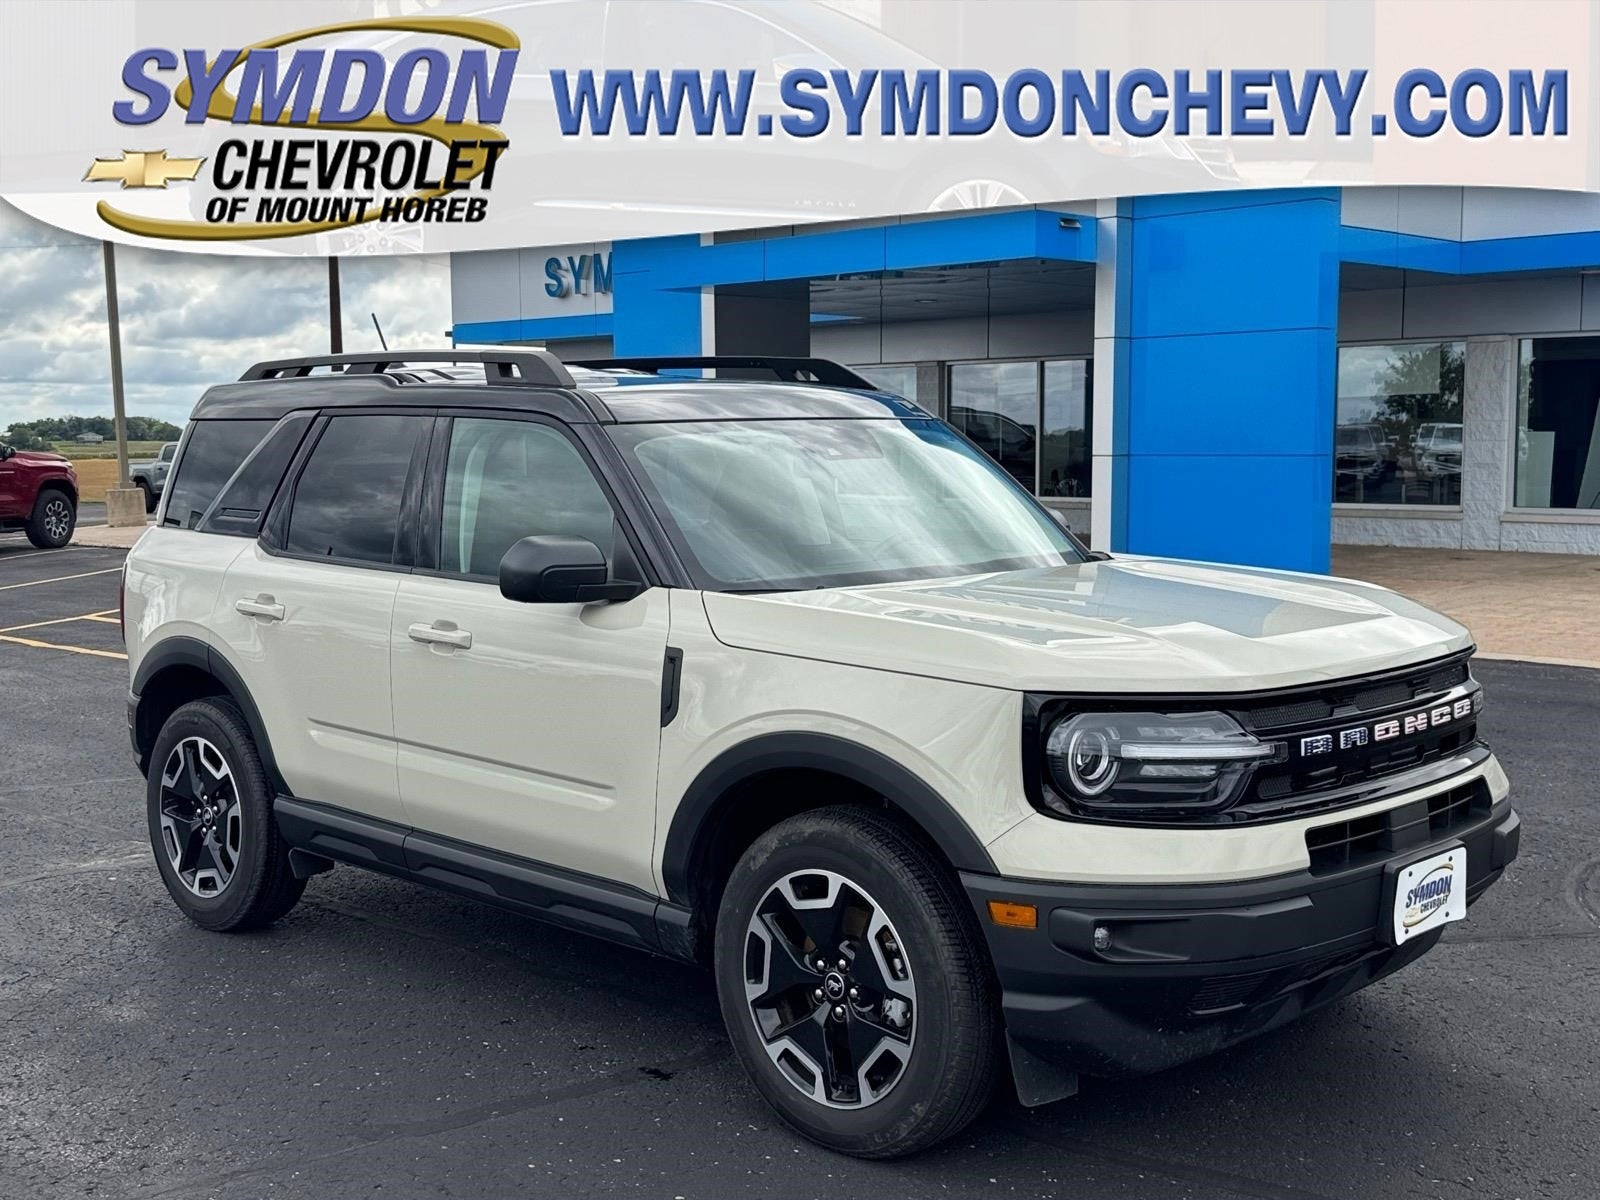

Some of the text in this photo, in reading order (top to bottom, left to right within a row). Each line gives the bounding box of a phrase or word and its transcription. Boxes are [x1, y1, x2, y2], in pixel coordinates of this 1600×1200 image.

[1300, 698, 1472, 757] BRONCO
[1405, 874, 1453, 909] SYMDON
[1420, 895, 1449, 914] CHEVROLET
